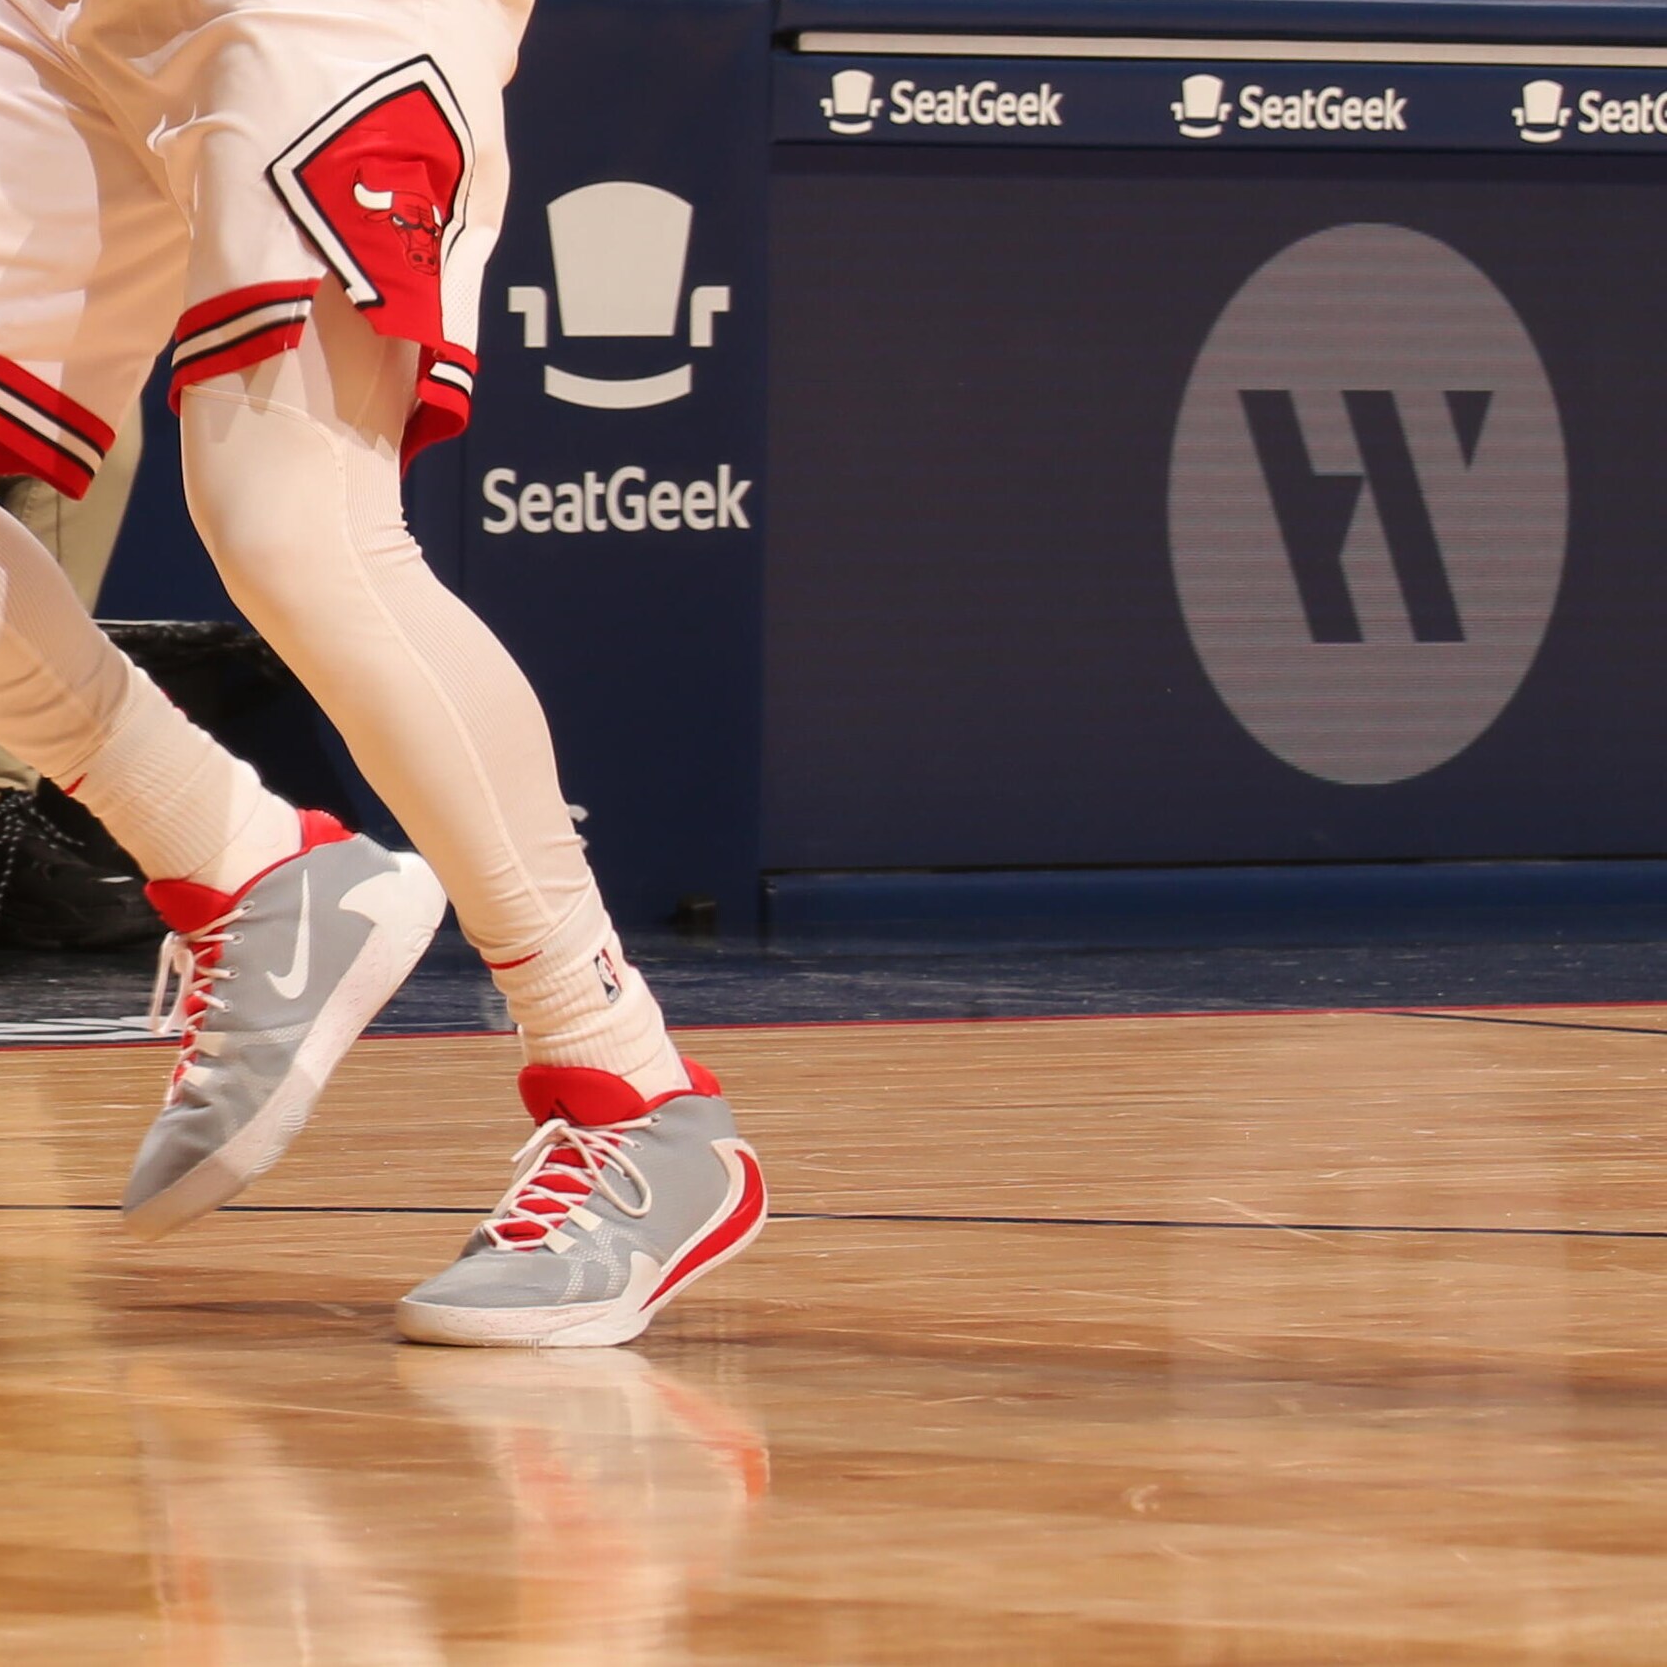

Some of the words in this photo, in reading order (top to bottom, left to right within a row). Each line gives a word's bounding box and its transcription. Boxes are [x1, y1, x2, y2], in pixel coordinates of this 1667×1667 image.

[889, 78, 1063, 129] SeatGeek
[1237, 84, 1408, 134] SeatGeek
[482, 463, 752, 534] SeatGeek
